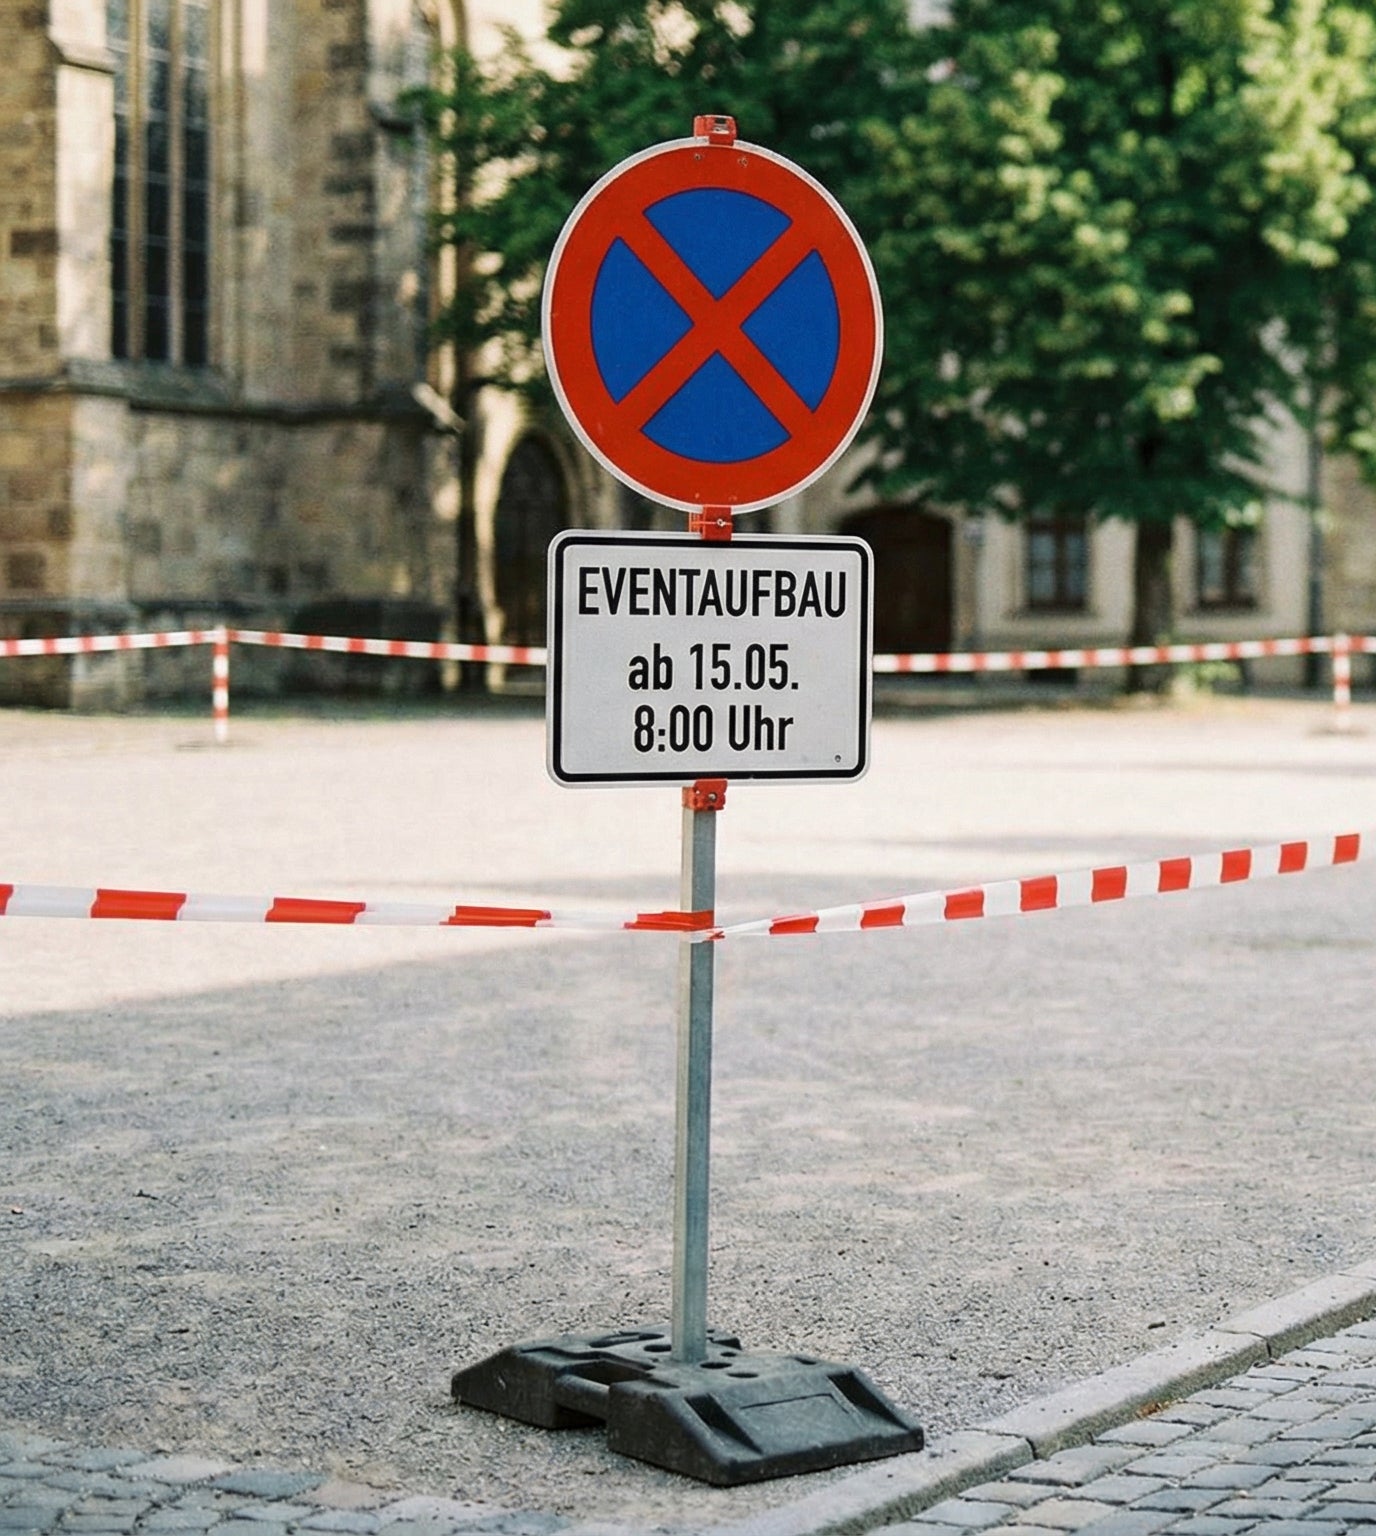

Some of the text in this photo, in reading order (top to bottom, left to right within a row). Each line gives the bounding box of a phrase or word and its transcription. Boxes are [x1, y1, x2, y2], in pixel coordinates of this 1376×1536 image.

[578, 566, 846, 618] EVENTAUFBAU
[628, 642, 799, 690] ab 15.05.
[634, 704, 794, 752] 8:00 Uhr
